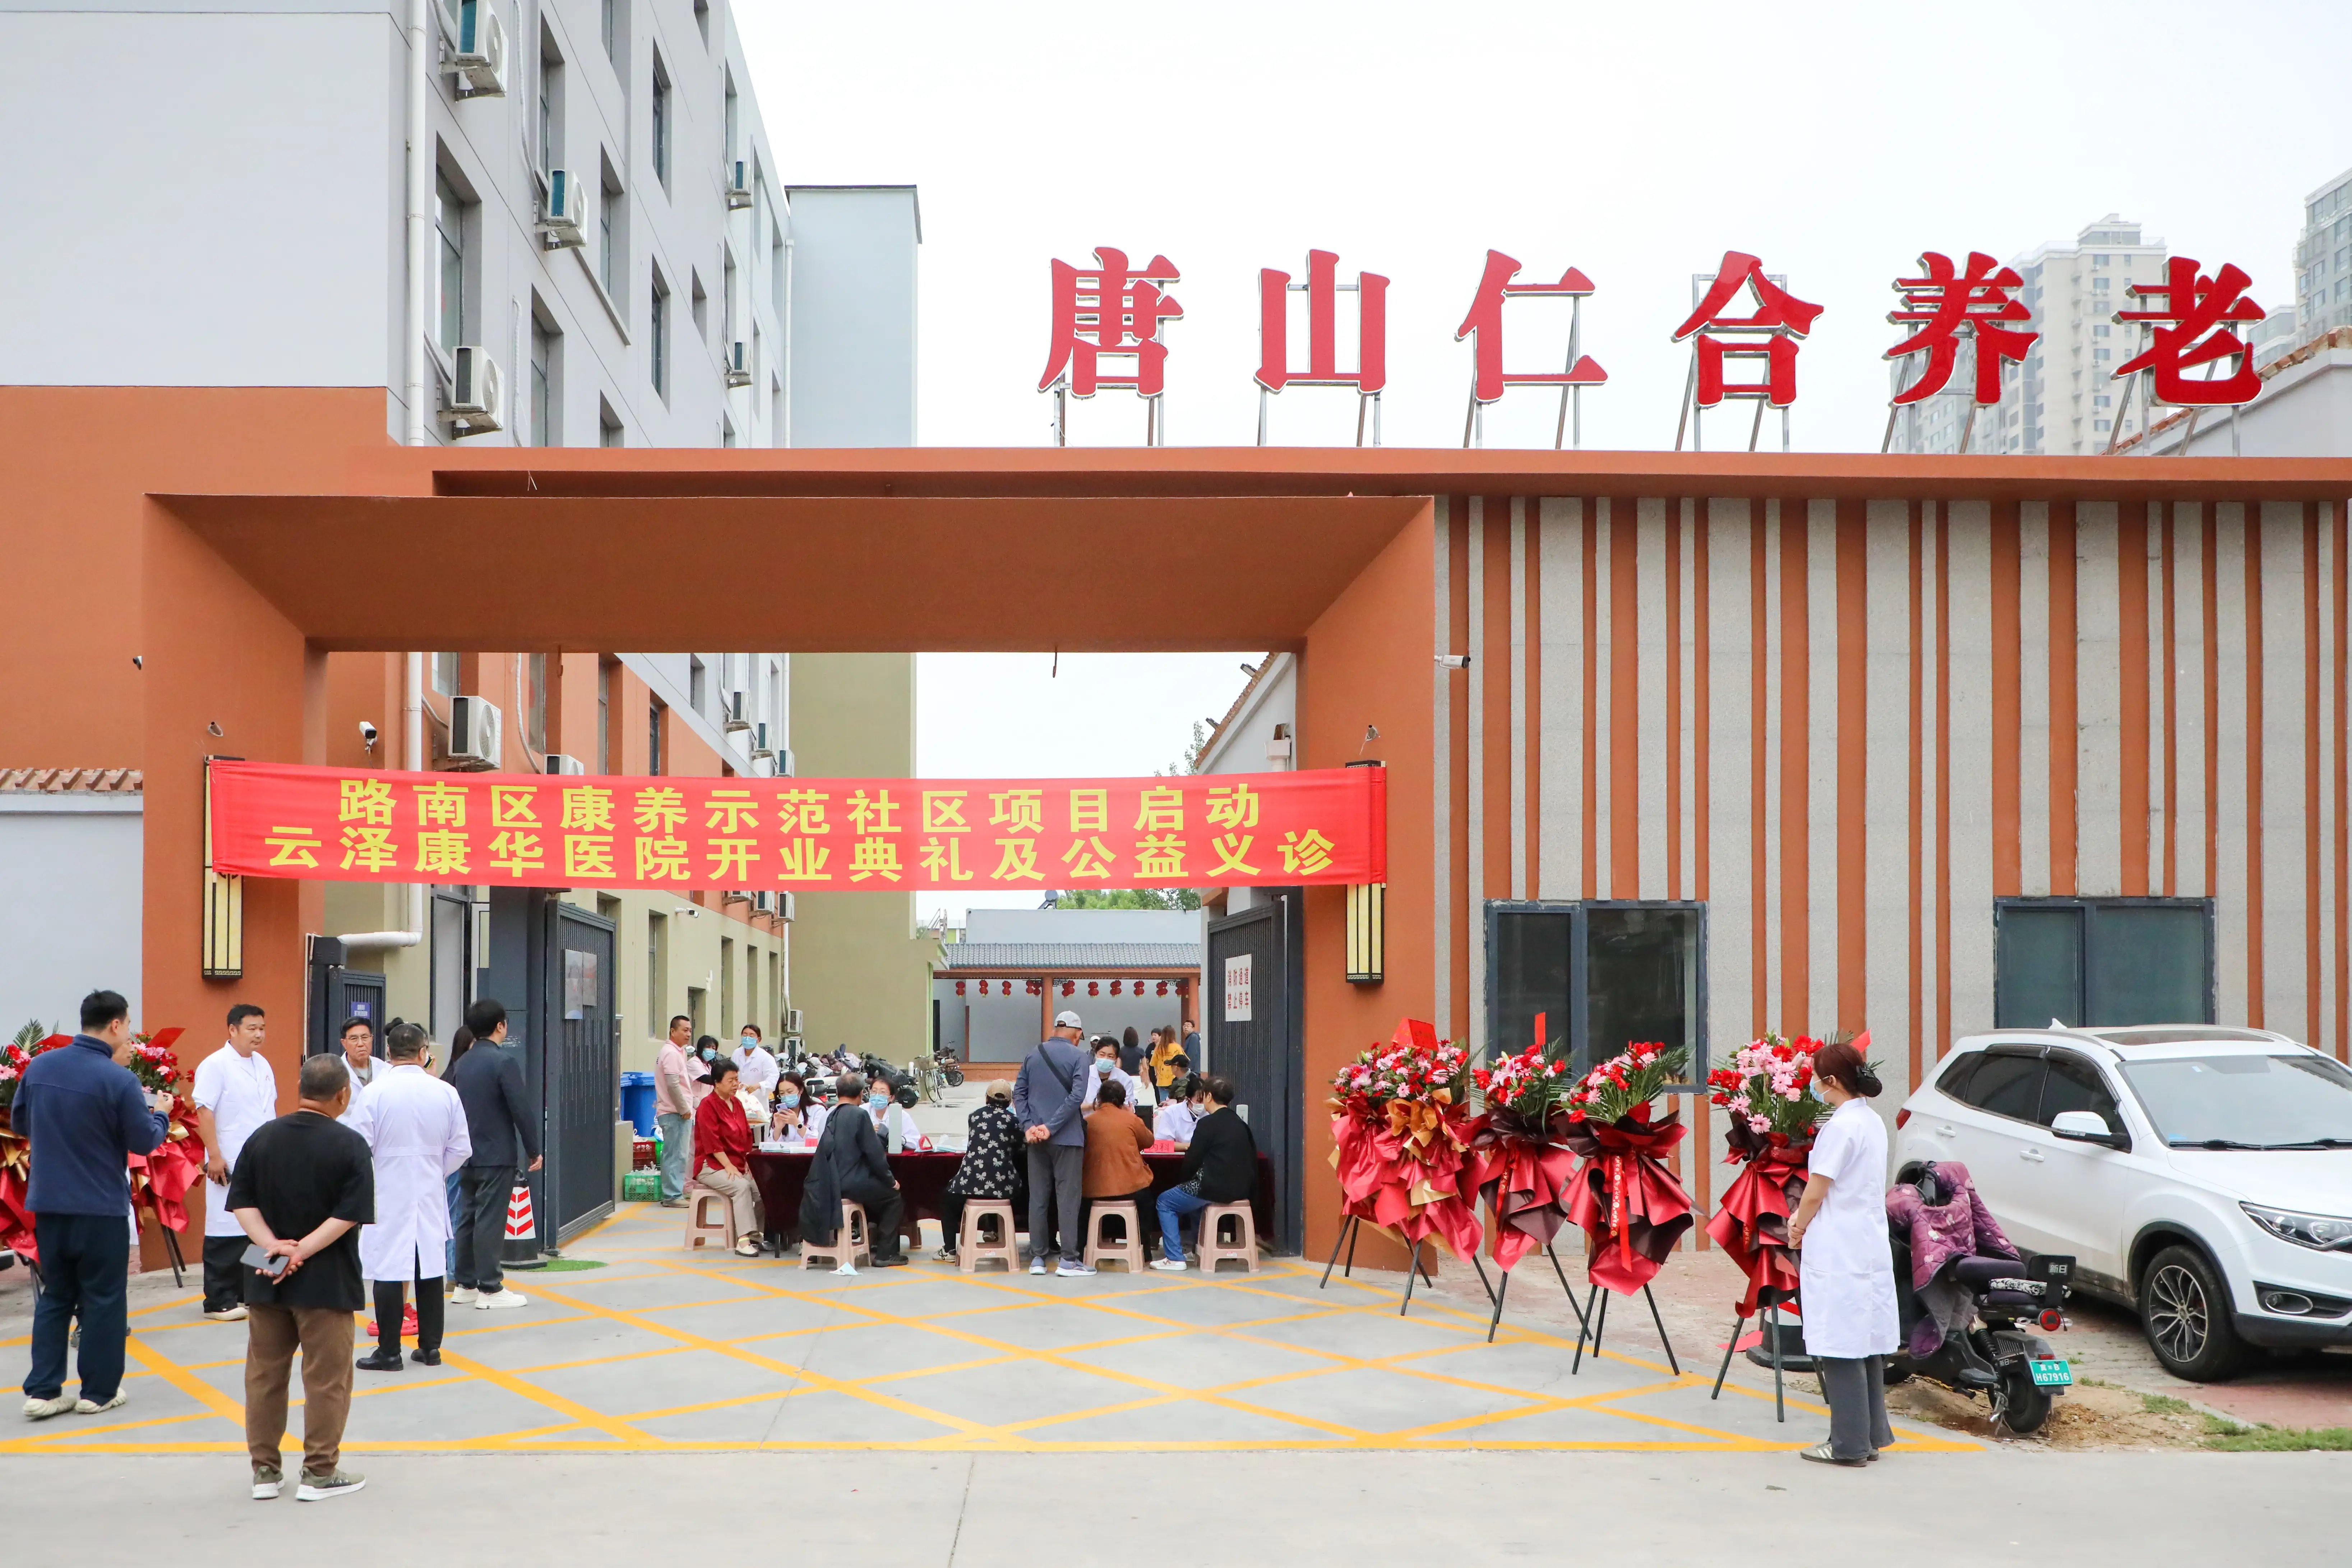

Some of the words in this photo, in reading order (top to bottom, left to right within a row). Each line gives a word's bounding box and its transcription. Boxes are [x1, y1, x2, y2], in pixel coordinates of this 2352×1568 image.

[1041, 247, 2265, 405] 唐山仁合养老
[338, 778, 1260, 834] 路南区康养示范社区项目启动
[265, 826, 1335, 882] 云泽康华医院开业典礼及公益义诊
[1228, 967, 1249, 987] 消防通道
[1228, 990, 1249, 1010] 禁止停车
[2050, 1264, 2067, 1273] 新日
[2036, 1372, 2069, 1382] H67916
